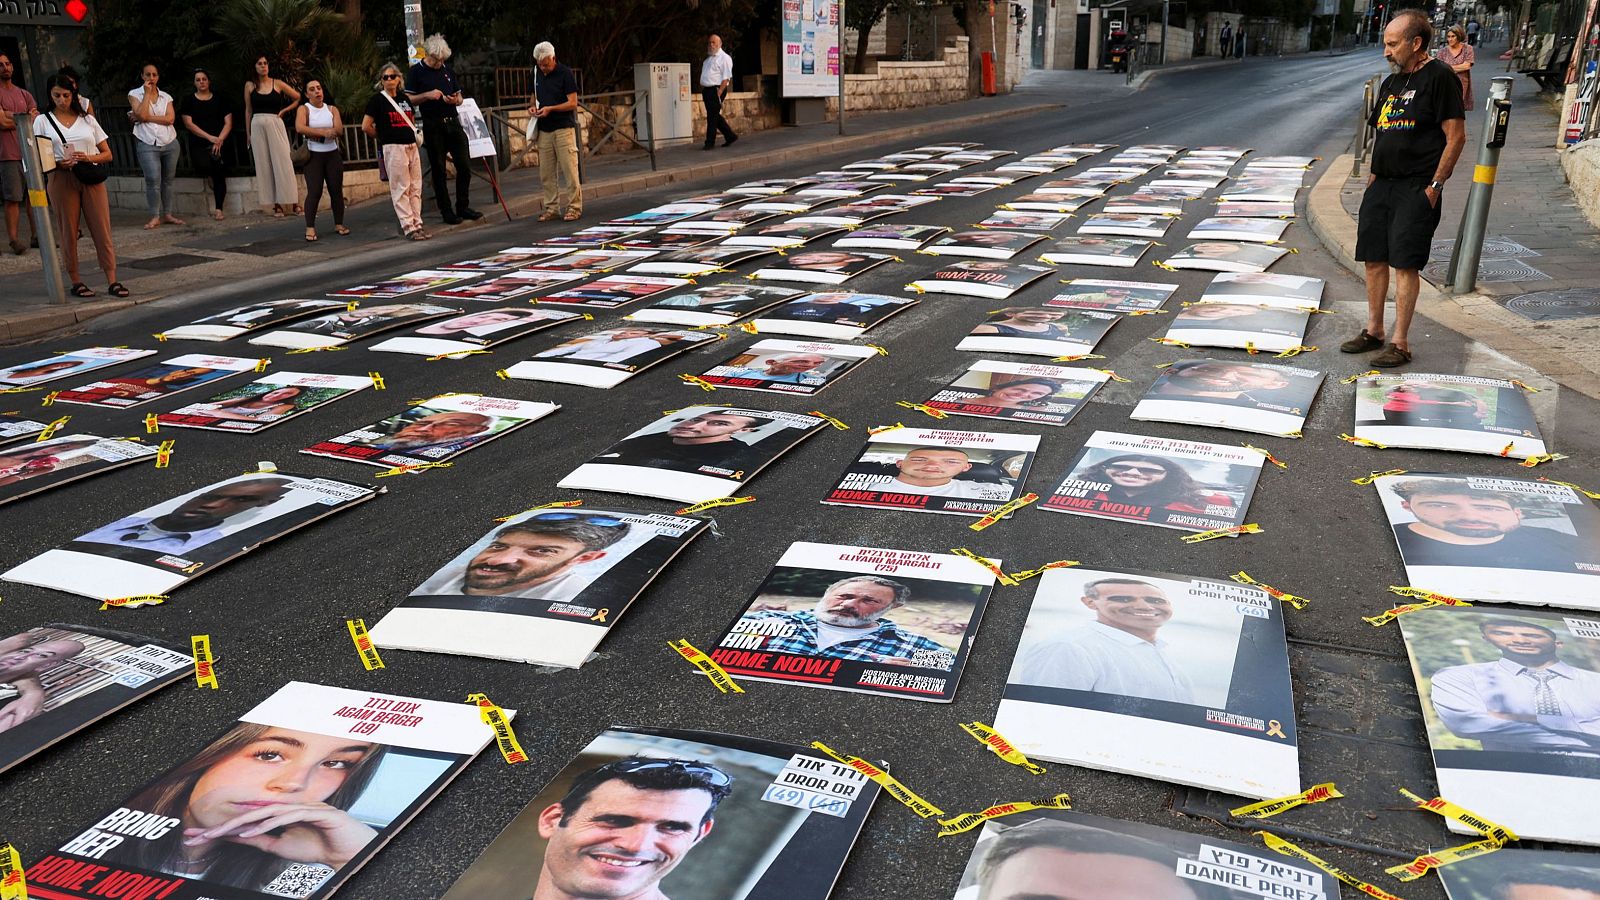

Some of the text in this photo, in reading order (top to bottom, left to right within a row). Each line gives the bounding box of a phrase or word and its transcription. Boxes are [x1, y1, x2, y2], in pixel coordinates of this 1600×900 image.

[962, 404, 1003, 414] NOW!
[837, 480, 870, 491] HIM
[844, 472, 893, 484] BRING
[1061, 479, 1113, 492] BRING
[830, 489, 930, 506] HOME NOW!
[1054, 486, 1089, 498] HIM
[1047, 495, 1153, 517] HOME NOW!
[623, 517, 688, 530] DAVID CUNIO
[839, 554, 943, 570] ELIYAHU MARGALIT
[874, 563, 899, 573] (75)
[1188, 588, 1221, 599] OMRI
[1224, 594, 1268, 607] MIRAN
[1231, 586, 1264, 598] עמרי
[1235, 603, 1265, 617] (46)
[731, 619, 797, 638] BRING
[719, 633, 766, 650] HIM
[133, 660, 170, 675] HORN
[709, 649, 843, 677] HOME NOW!
[859, 674, 945, 693] FAMILIES FORUM
[862, 669, 947, 685] HOSTAGES AND MISSING
[333, 706, 424, 728] AGAM BERGER
[349, 721, 380, 736] (19)
[986, 734, 1015, 756] NOW!
[796, 757, 826, 772] אור
[783, 772, 856, 797] DROR OR
[850, 759, 881, 777] NOW!
[887, 783, 913, 804] BRING
[910, 801, 934, 817] THEM
[765, 786, 805, 806] (49)
[95, 807, 181, 840] BRING
[1458, 813, 1491, 832] BRING
[58, 829, 125, 860] HER
[1211, 849, 1315, 887] דניאל פרץ
[25, 855, 110, 891] HOME
[89, 869, 186, 900] NOW!
[1185, 862, 1319, 900] DANIEL PEREZ
